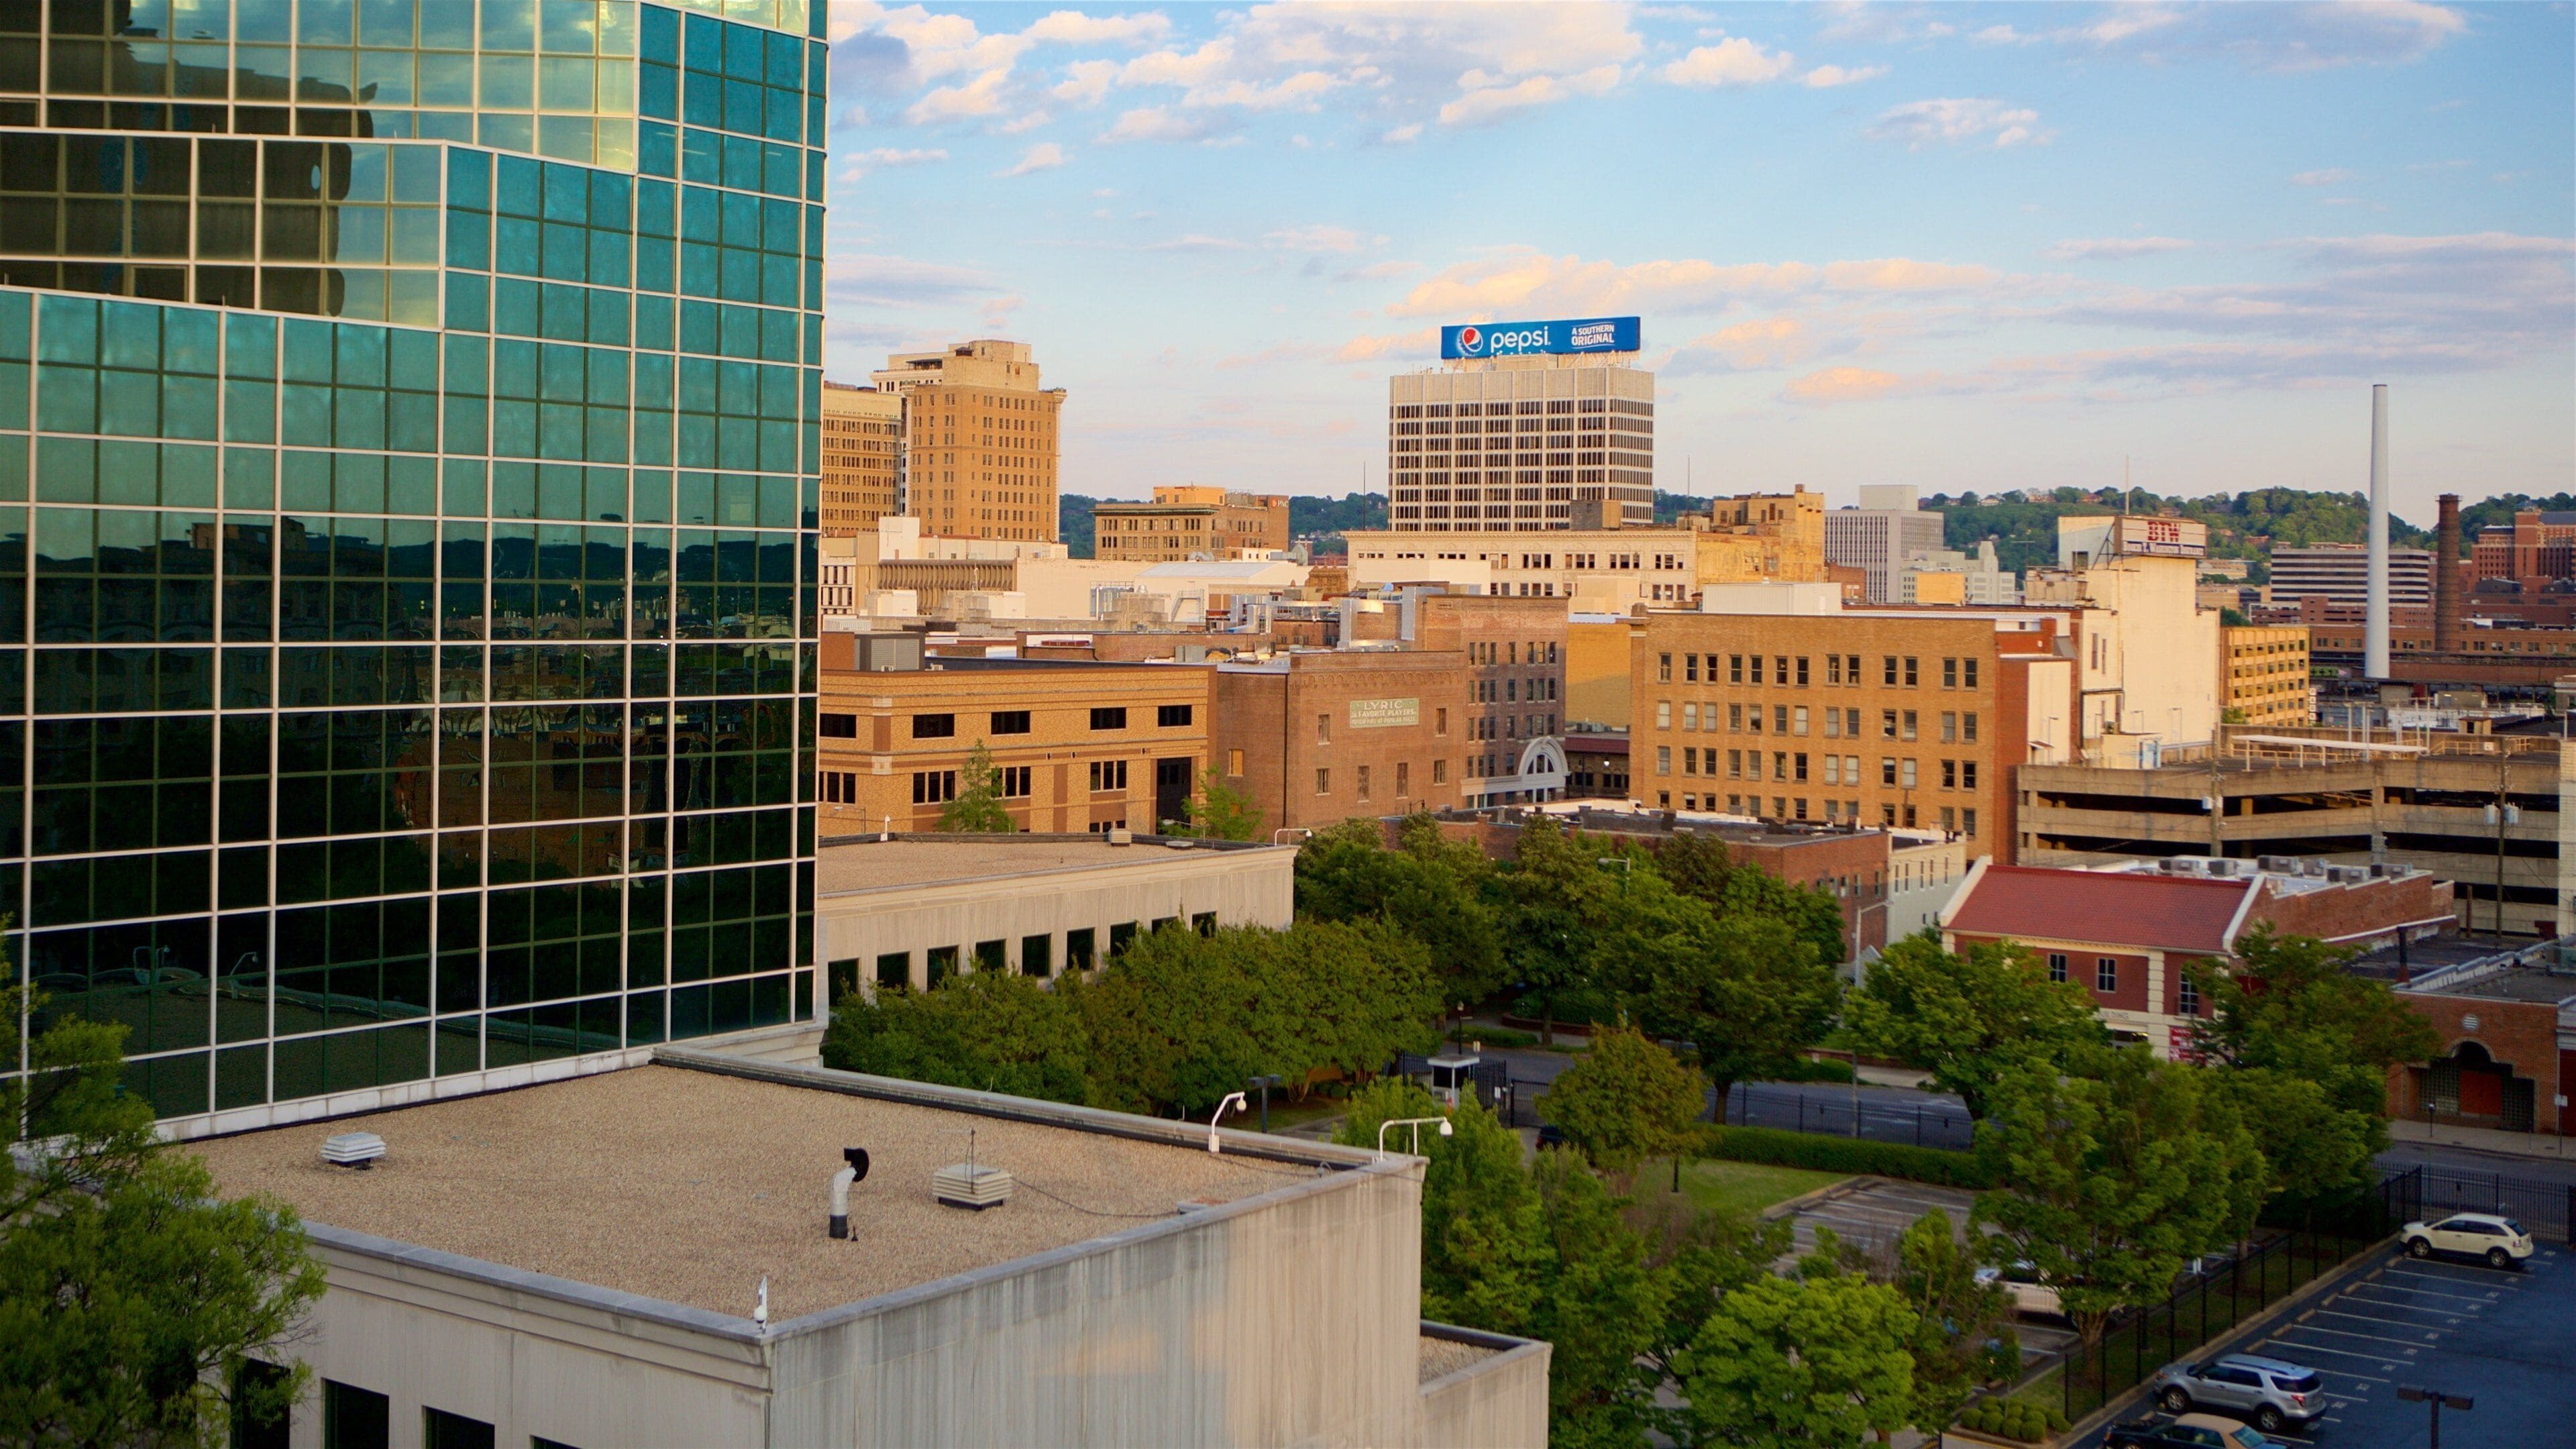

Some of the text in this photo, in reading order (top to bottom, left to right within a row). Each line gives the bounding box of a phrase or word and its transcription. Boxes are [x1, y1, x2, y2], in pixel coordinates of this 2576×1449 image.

[1571, 324, 1615, 335] A SOUTHERN
[1491, 325, 1549, 354] pepsi
[1571, 333, 1615, 345] ORIGINAL
[2147, 521, 2181, 542] BTW
[1364, 700, 1403, 710] LYRIC
[1387, 708, 1415, 716] PLAYERS
